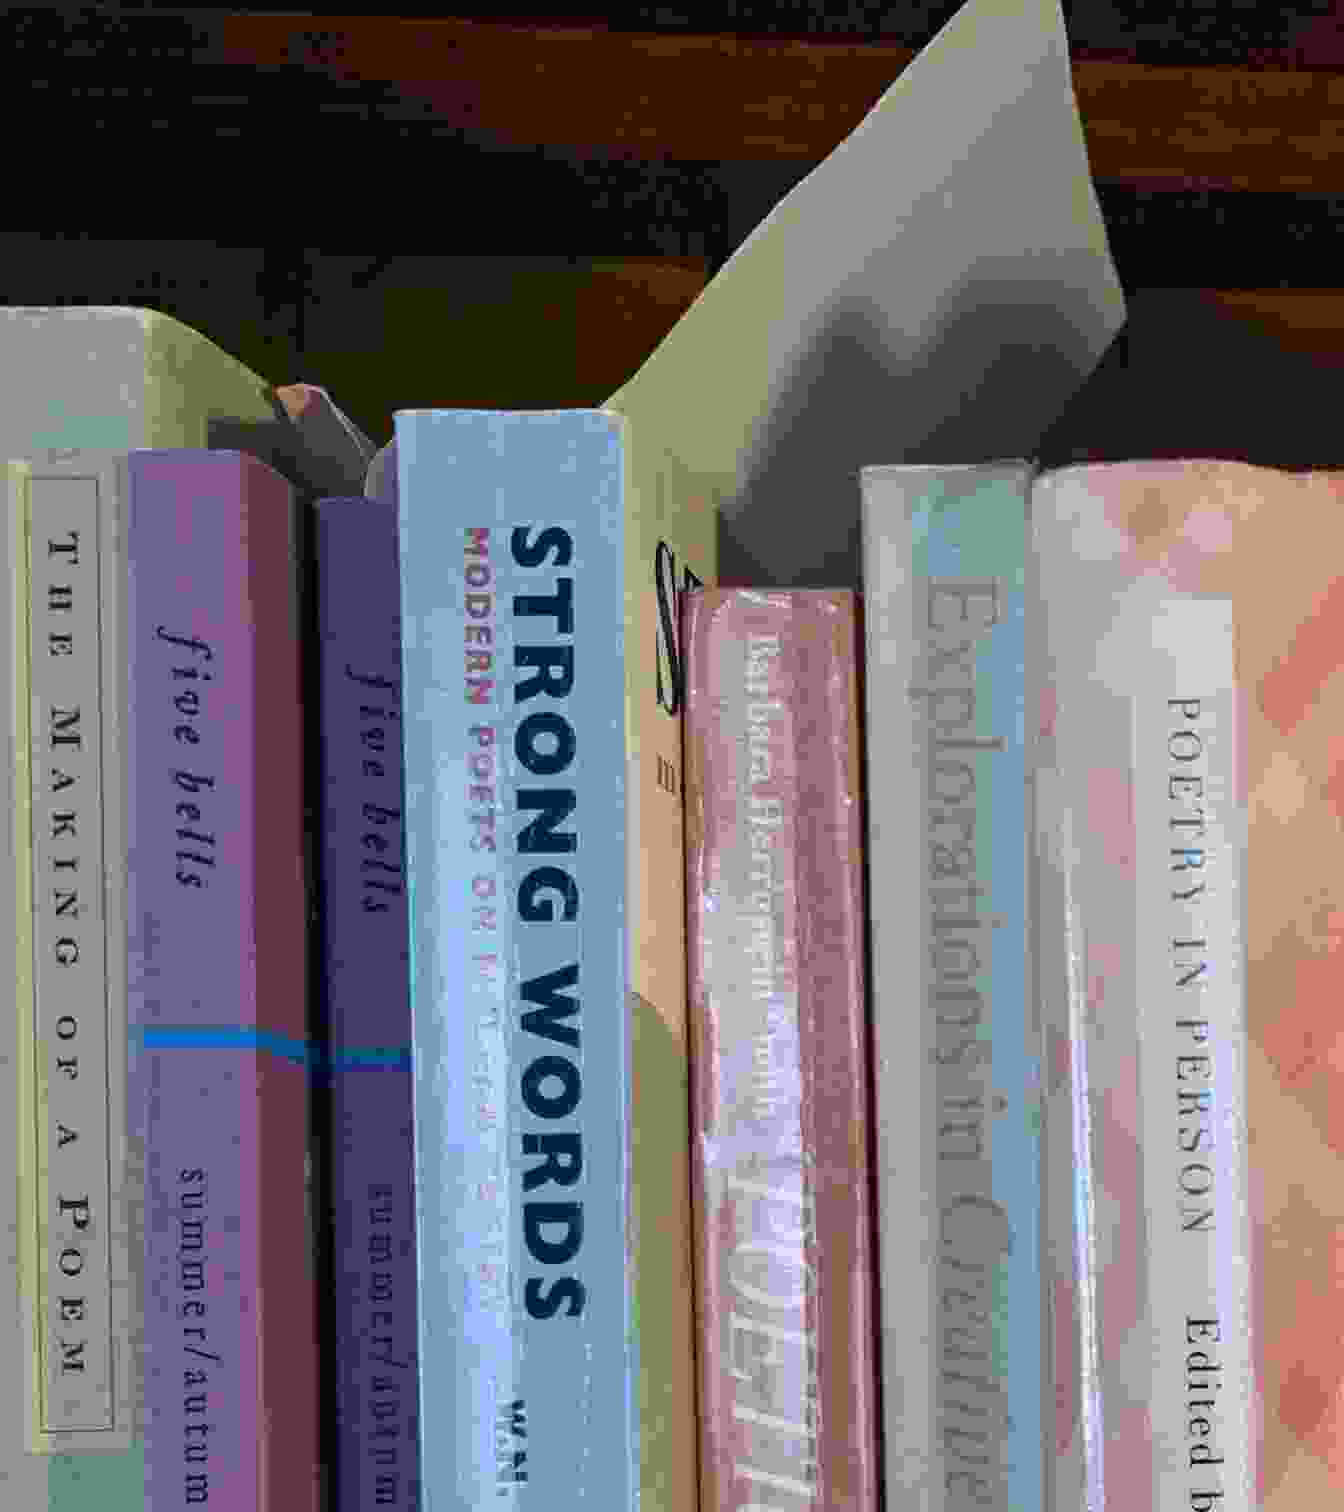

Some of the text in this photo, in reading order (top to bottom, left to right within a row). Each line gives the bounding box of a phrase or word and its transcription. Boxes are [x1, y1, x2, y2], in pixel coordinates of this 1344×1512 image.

[152, 624, 215, 888] five bells
[346, 664, 402, 912] five bells
[463, 526, 497, 852] MODERN POETS
[743, 632, 782, 783] Barbara
[905, 578, 1006, 1065] Explorations
[47, 530, 90, 1376] THE MAKING OF A POEM
[511, 525, 587, 1321] STRONG WORDS
[1167, 698, 1215, 1233] POETRY IN PERSON
[940, 1093, 1007, 1161] in
[939, 1194, 1010, 1503] Creative
[1184, 1316, 1224, 1467] Edited
